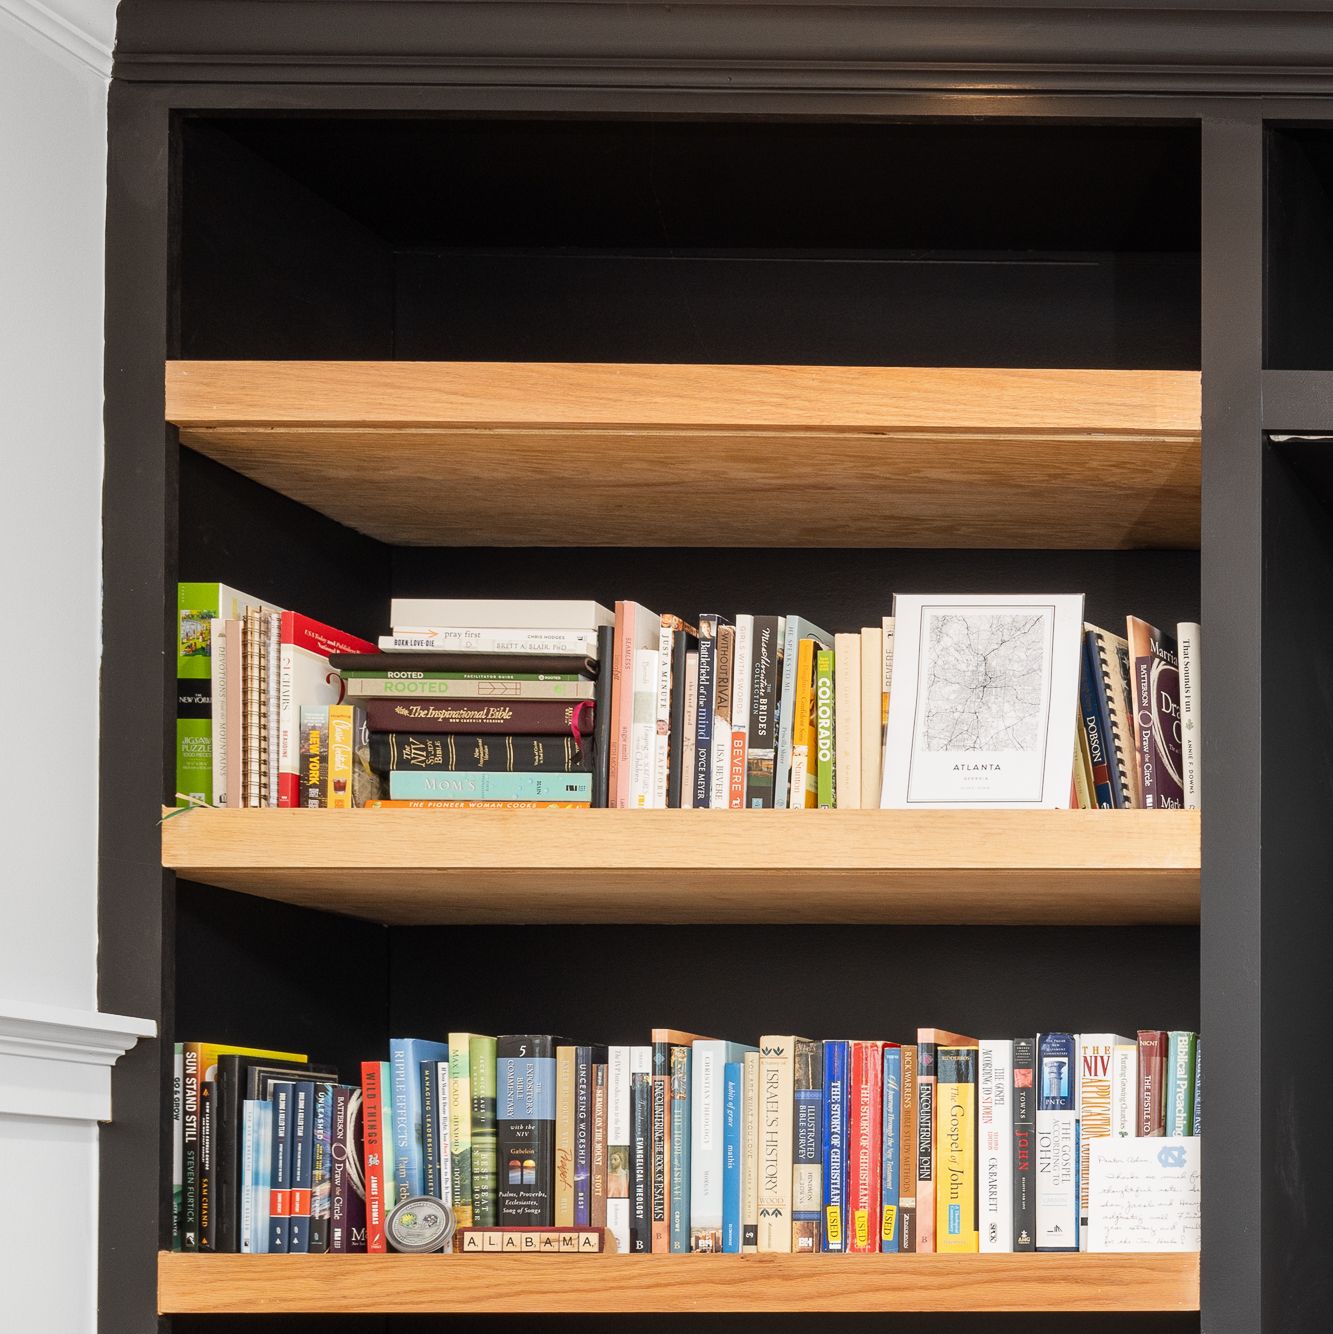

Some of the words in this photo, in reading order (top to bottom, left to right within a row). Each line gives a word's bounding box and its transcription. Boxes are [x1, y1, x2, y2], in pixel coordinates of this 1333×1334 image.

[444, 630, 462, 640] pray
[464, 630, 481, 639] first
[699, 641, 711, 685] Battlefield
[1182, 639, 1191, 660] That
[384, 682, 448, 693] ROOTED
[387, 671, 424, 679] ROOTED
[753, 662, 761, 715] COLLECTION
[1140, 664, 1149, 707] BATTERSON
[1183, 661, 1191, 693] Sounds
[698, 695, 707, 707] the
[699, 686, 707, 695] of
[1184, 695, 1193, 713] Fun
[409, 706, 427, 719] The
[426, 708, 488, 721] Inspirational
[487, 706, 512, 720] Bible
[697, 708, 710, 740] mind
[818, 677, 831, 762] COLORADO
[309, 730, 320, 754] NEW
[403, 742, 412, 760] The
[410, 738, 426, 767] NIV
[1086, 716, 1102, 763] DOBSON
[1142, 730, 1151, 753] Draw
[698, 748, 707, 771] JOYCE
[716, 744, 725, 764] LISA
[733, 739, 743, 791] BEVERE
[309, 756, 320, 785] YORK
[424, 777, 476, 791] MOM'S
[715, 765, 724, 800] BEVERE
[1143, 763, 1152, 787] Circle
[697, 773, 705, 800] MEYER
[185, 1052, 197, 1074] SUN
[519, 1045, 526, 1058] 5
[904, 1051, 912, 1070] RICK
[1081, 1046, 1111, 1054] THE
[1177, 1036, 1188, 1079] Biblical
[394, 1050, 405, 1092] RIPPLE
[1082, 1056, 1110, 1077] NIV
[185, 1077, 197, 1112] STAND
[366, 1072, 376, 1099] WILD
[452, 1072, 460, 1107] LUCADO
[506, 1059, 515, 1119] COMMENTARY
[578, 1064, 587, 1119] UNCEASING
[727, 1081, 736, 1101] habits
[766, 1069, 783, 1127] ISRAEL'S
[904, 1071, 912, 1108] WARREN'S
[950, 1087, 959, 1103] The
[317, 1092, 325, 1140] UNLEASHED
[336, 1096, 344, 1139] BATTERSON
[654, 1081, 664, 1140] ENCOUNTERING
[727, 1101, 735, 1109] of
[798, 1105, 806, 1127] BIBLE
[919, 1086, 931, 1152] ENCOUNTERING
[1173, 1080, 1187, 1137] Preaching
[185, 1115, 197, 1143] STILL
[367, 1105, 377, 1145] THINGS
[396, 1095, 408, 1147] EFFECTS
[807, 1105, 815, 1159] ILLUSTRATED
[948, 1105, 964, 1152] Gospel
[1061, 1121, 1071, 1140] THE
[1143, 1122, 1151, 1133] TO
[425, 1114, 433, 1161] LEADERSHIP
[578, 1123, 586, 1165] WORSHIP
[655, 1140, 663, 1154] THE
[798, 1128, 806, 1160] SURVEY
[903, 1128, 911, 1154] STUDY
[1017, 1130, 1029, 1171] JOHN
[1052, 1118, 1060, 1170] ACCORDING
[480, 1154, 489, 1179] BEST
[636, 1137, 644, 1182] EVANGELICAL
[655, 1154, 664, 1173] BOOK
[727, 1145, 735, 1169] mathis
[765, 1131, 784, 1195] HISTORY
[949, 1155, 959, 1164] of
[1038, 1131, 1052, 1174] JOHN
[1061, 1144, 1071, 1185] GOSPEL
[187, 1150, 195, 1184] STEVEN
[334, 1163, 343, 1186] Draw
[903, 1155, 911, 1193] METHODS
[919, 1156, 931, 1179] JOHN
[1052, 1173, 1060, 1186] TO
[201, 1178, 209, 1195] SAM
[370, 1176, 378, 1195] JAMES
[948, 1167, 966, 1200] John
[187, 1186, 195, 1223] FURTICK
[333, 1197, 342, 1220] Circle
[481, 1184, 489, 1212] SEAT
[502, 1207, 517, 1215] Song
[524, 1207, 541, 1215] Songs
[654, 1183, 664, 1219] PSALMS
[201, 1197, 209, 1228] CHAND
[371, 1201, 379, 1225] THOMAS
[830, 1210, 839, 1238] USED
[883, 1209, 894, 1236] USED
[856, 1216, 866, 1242] USED
[988, 1223, 997, 1243] SPCK
